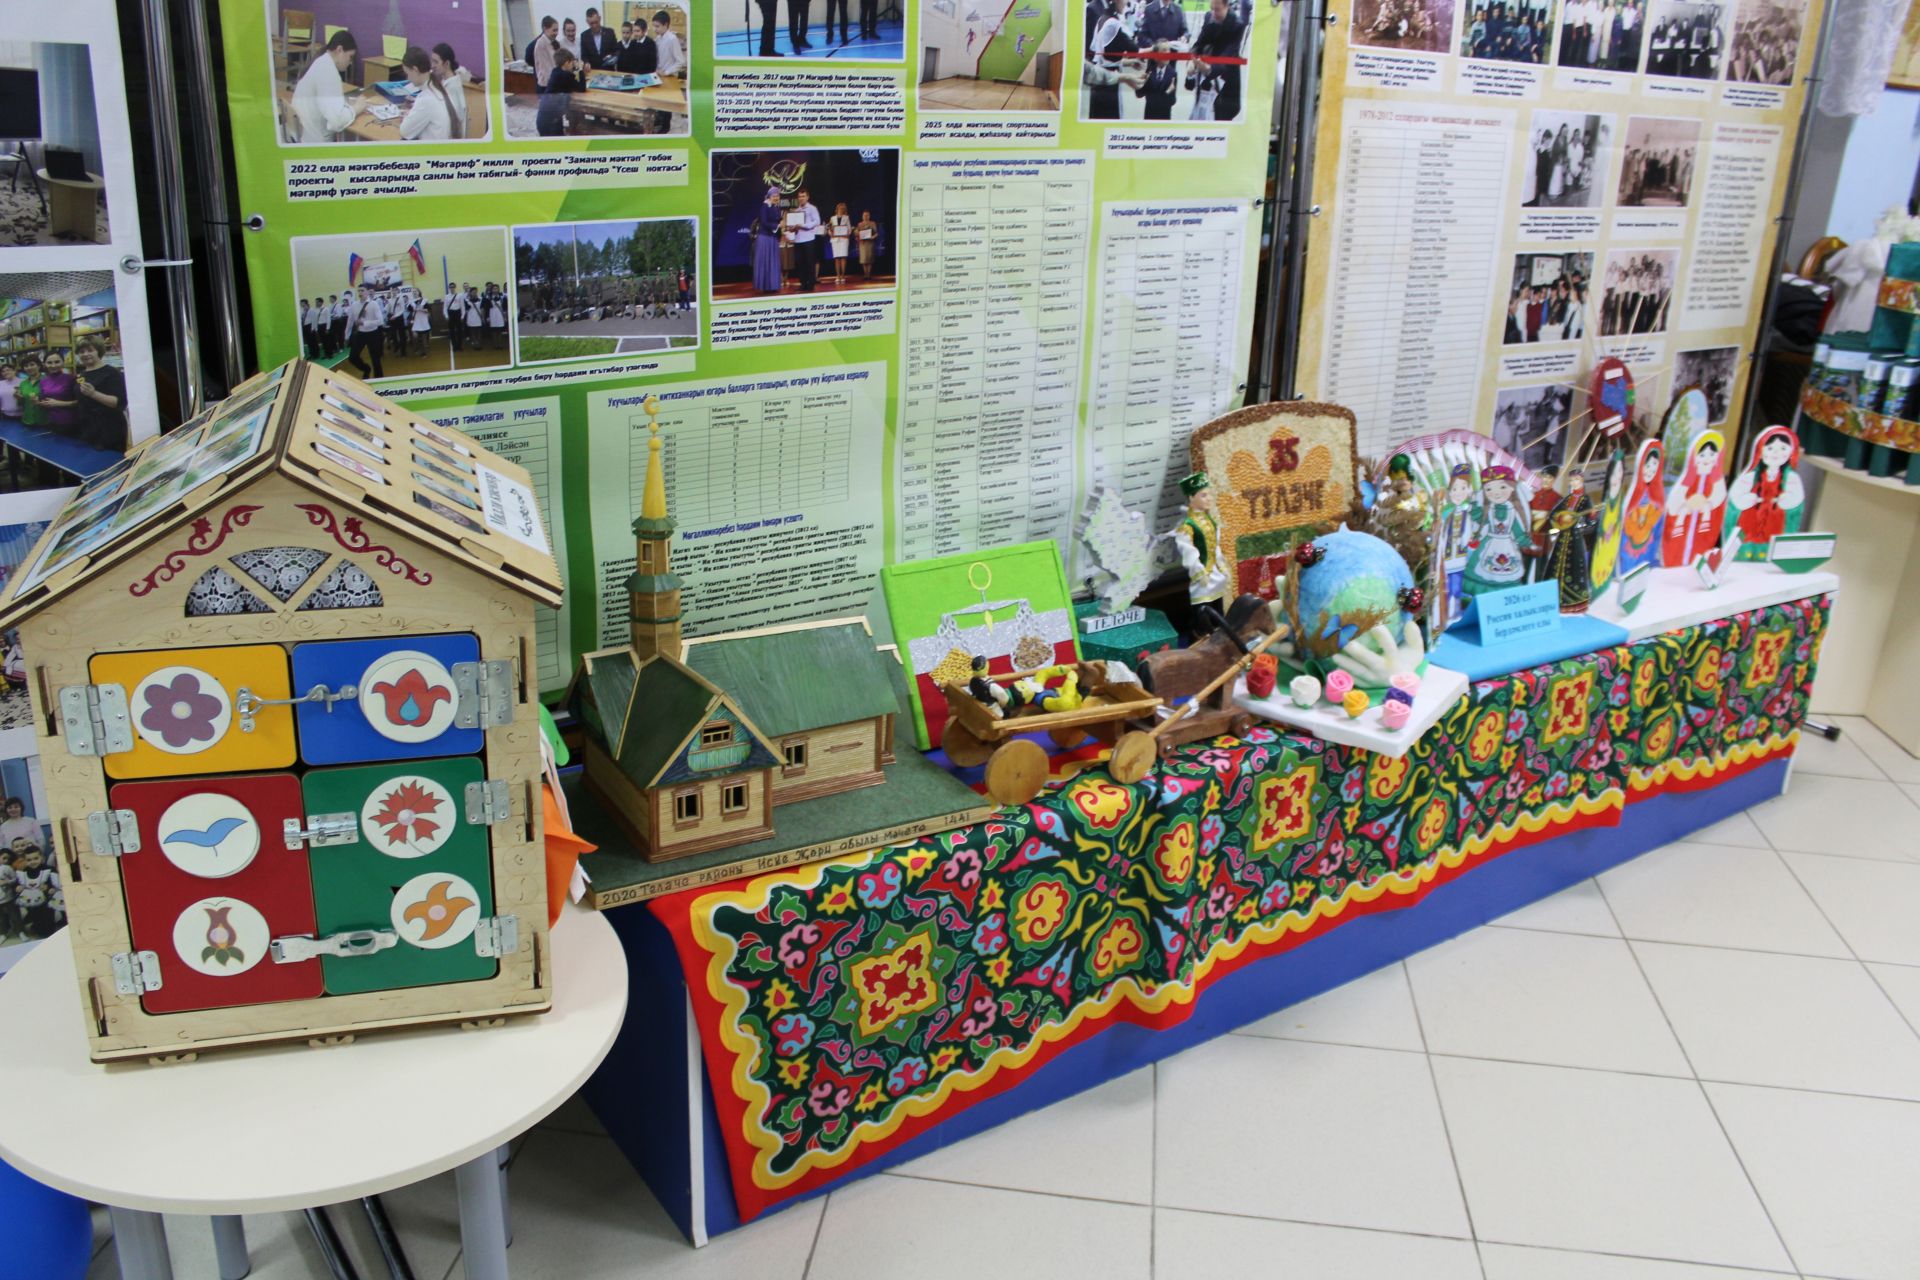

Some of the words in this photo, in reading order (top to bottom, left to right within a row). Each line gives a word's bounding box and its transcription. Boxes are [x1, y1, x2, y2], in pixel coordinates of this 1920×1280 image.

[290, 164, 317, 173] 2022
[319, 165, 345, 173] елда
[348, 161, 420, 171] мәктәбебездә
[426, 159, 480, 169] "Мәгариф"
[482, 160, 513, 170] милли
[521, 158, 561, 166] проекты
[564, 155, 607, 163] "Заманча
[609, 154, 645, 166] мәктәп"
[288, 177, 334, 186] проекты
[349, 174, 420, 184] кысаларында
[456, 170, 475, 178] һәм
[478, 169, 523, 177] табигый-
[524, 168, 555, 177] фәнни
[557, 166, 609, 176] профильдә
[612, 165, 638, 173] "Үсеш
[646, 164, 685, 172] ноктасы"
[289, 188, 337, 198] мәгариф
[340, 188, 368, 196] үзәге
[373, 186, 418, 194] ачылды.
[410, 383, 459, 394] укучыларга
[460, 379, 502, 388] патриотик
[505, 374, 532, 384] тәрбия
[533, 372, 552, 381] бирү
[554, 370, 587, 378] һәрдаим
[589, 365, 624, 374] игътибар
[625, 363, 658, 371] үзәгендә
[496, 440, 530, 452] Ләйсән
[1268, 436, 1300, 474] 35
[602, 890, 636, 905] 2020
[840, 834, 878, 850] авылы
[944, 813, 970, 826] 1441
